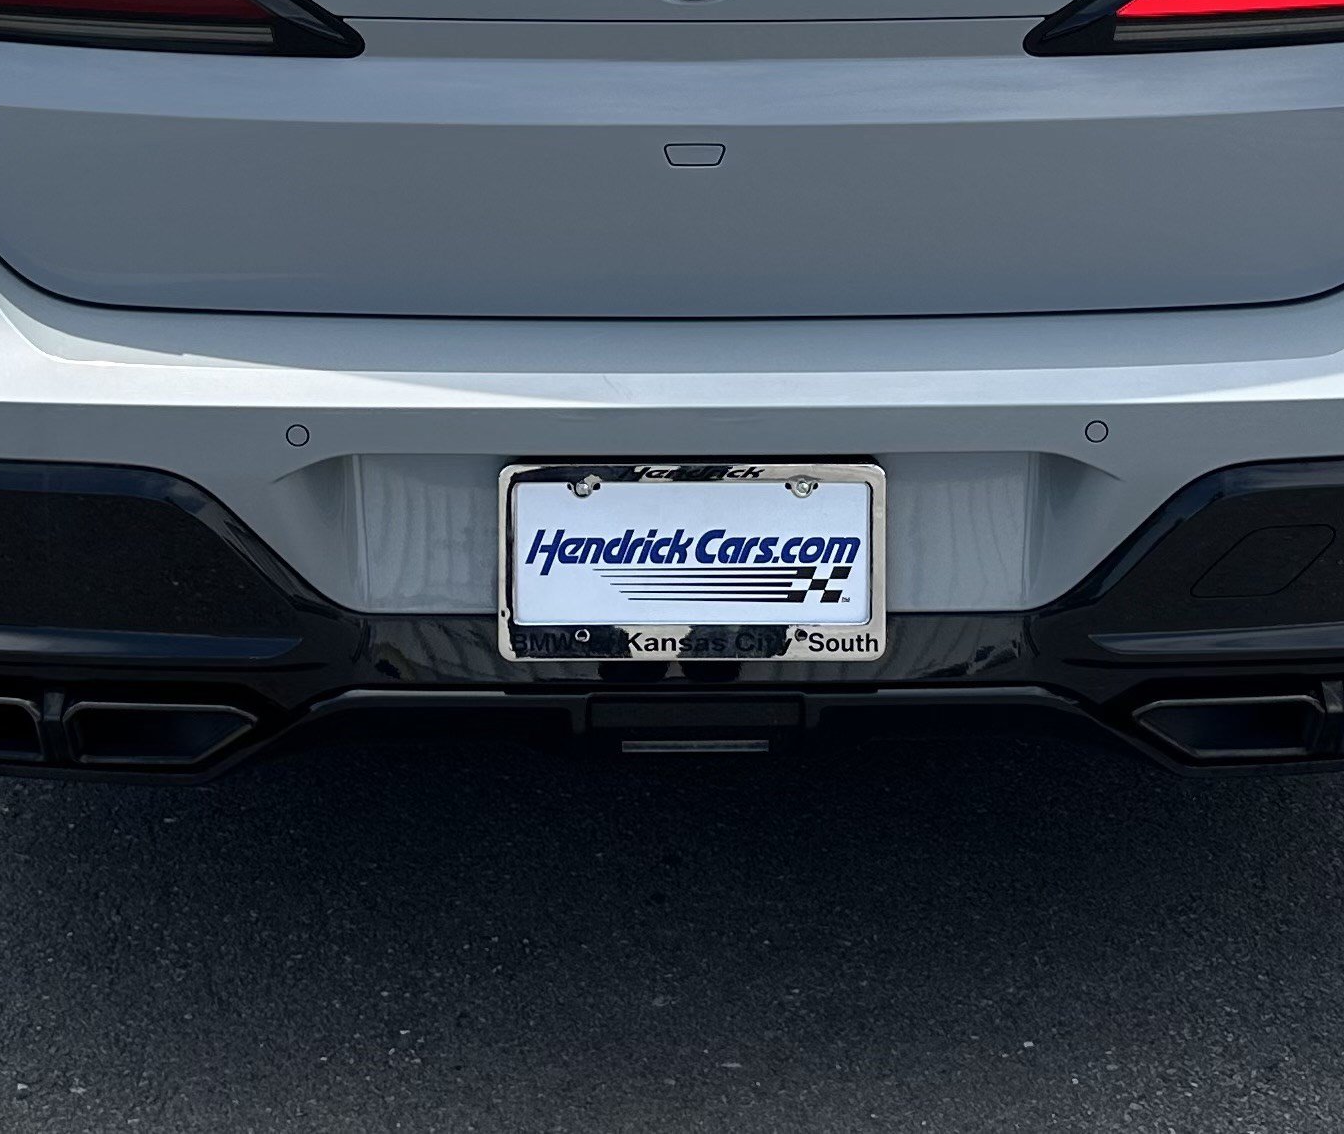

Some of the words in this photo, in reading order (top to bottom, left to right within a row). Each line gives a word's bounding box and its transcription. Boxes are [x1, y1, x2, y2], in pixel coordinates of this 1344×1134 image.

[512, 632, 573, 652] BMW
[626, 632, 727, 652] Kansas
[735, 631, 792, 656] City
[807, 632, 879, 652] South
